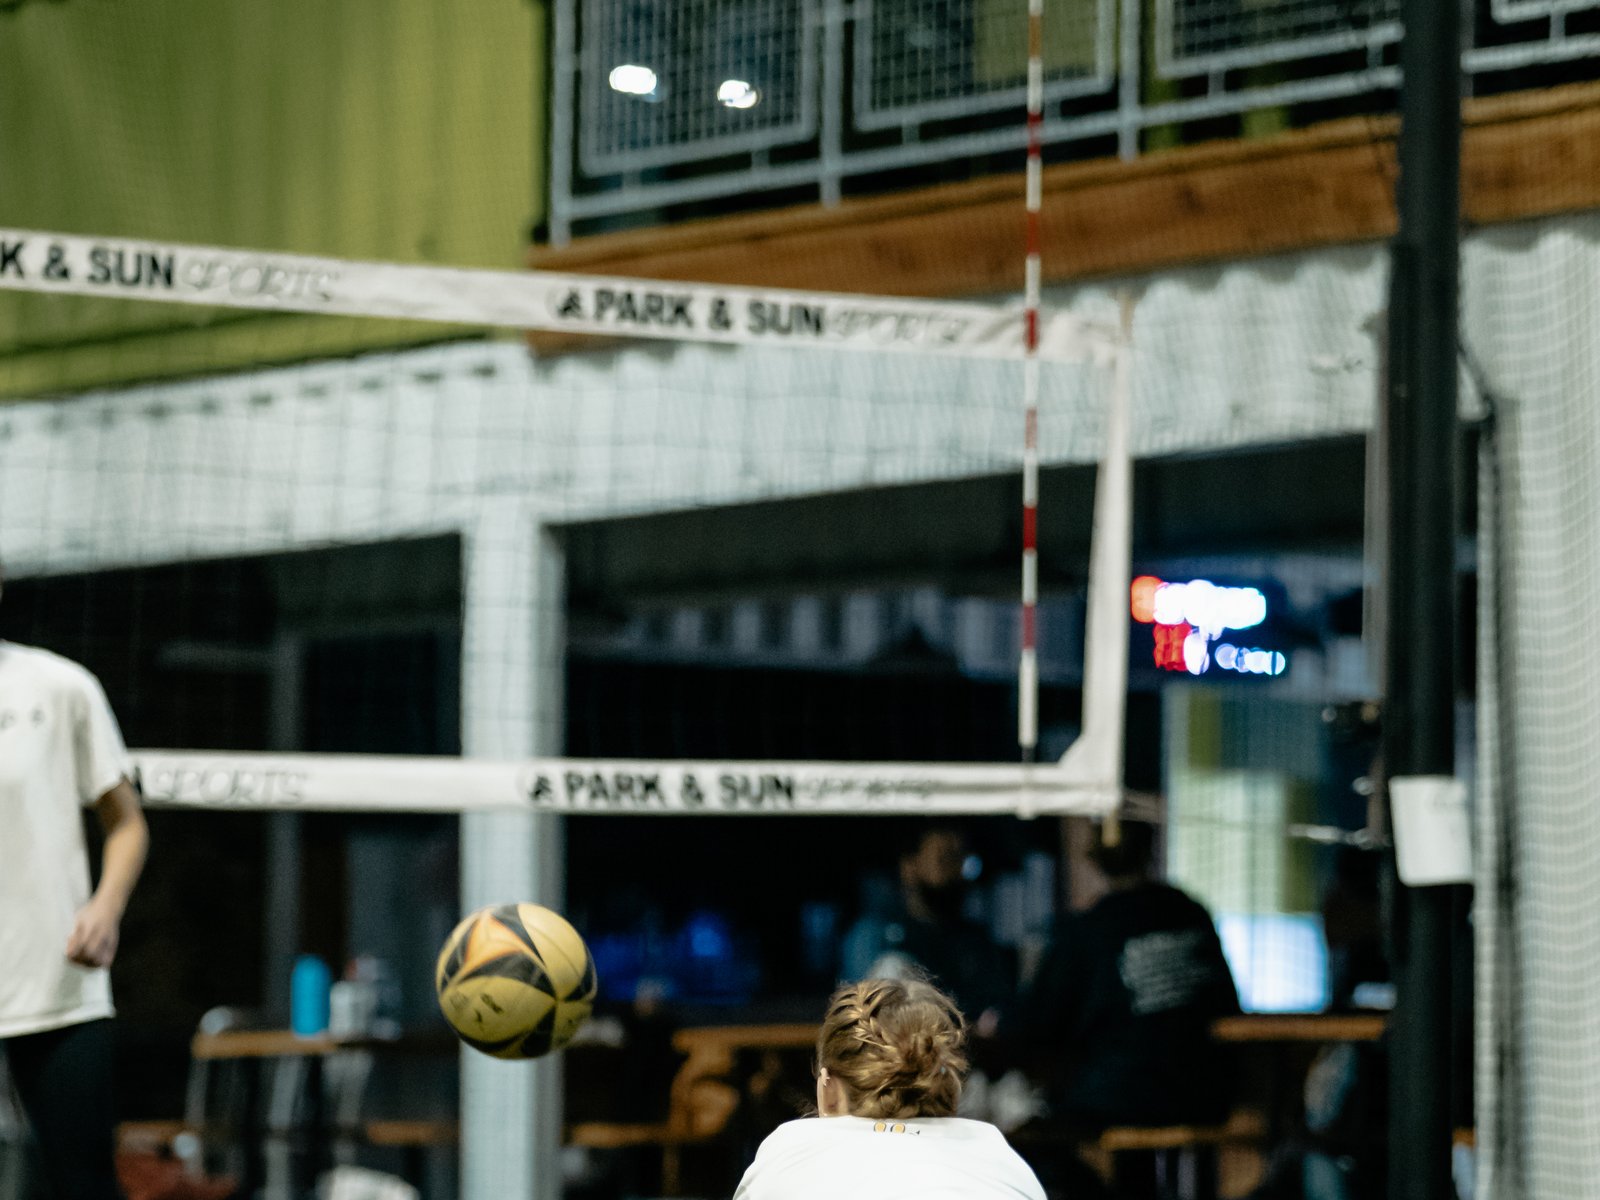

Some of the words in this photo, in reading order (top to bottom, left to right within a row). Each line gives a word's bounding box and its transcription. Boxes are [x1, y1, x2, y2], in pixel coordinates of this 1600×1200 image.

[43, 245, 69, 280] &
[86, 246, 174, 287] SUN
[594, 288, 694, 328] PARK
[708, 297, 732, 331] &
[747, 301, 825, 336] SUN
[564, 771, 664, 804] PARK
[681, 774, 705, 804] &
[718, 774, 794, 807] SUN
